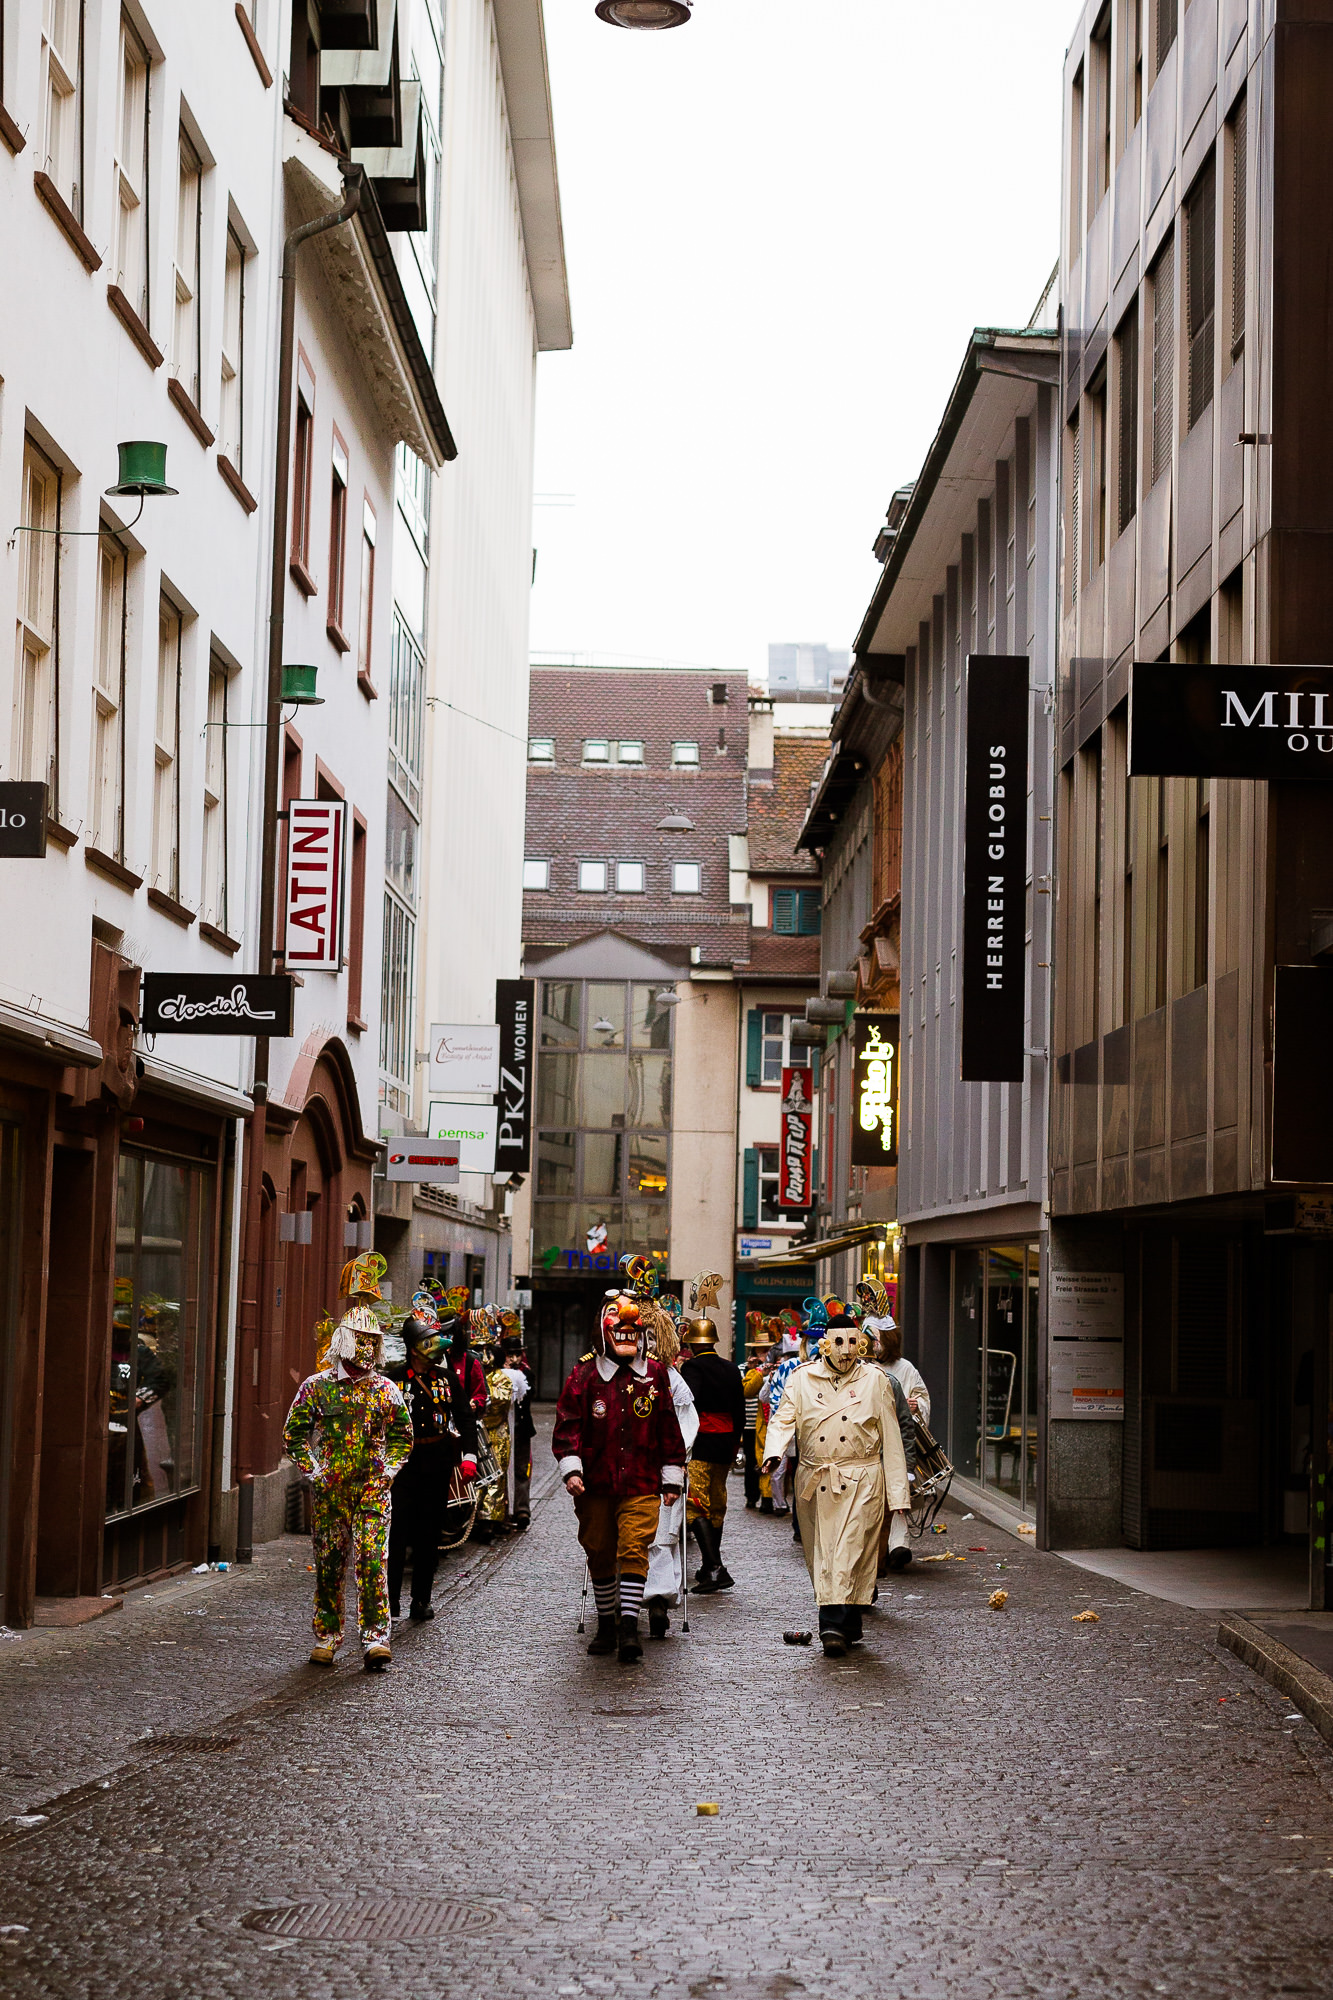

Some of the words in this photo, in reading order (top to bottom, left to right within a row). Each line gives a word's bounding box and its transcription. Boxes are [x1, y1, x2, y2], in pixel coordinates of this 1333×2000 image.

[1220, 691, 1333, 729] MIL
[988, 745, 1007, 860] GLOBUS
[289, 808, 330, 960] LATINI
[986, 875, 1005, 989] HERREN
[158, 984, 276, 1022] doodah
[499, 1066, 526, 1150] PKZ
[514, 1000, 527, 1062] WOMEN
[438, 1129, 485, 1140] pemsa
[786, 1113, 807, 1140] UP
[408, 1155, 459, 1166] SIDESTEP
[562, 1250, 627, 1270] Thal
